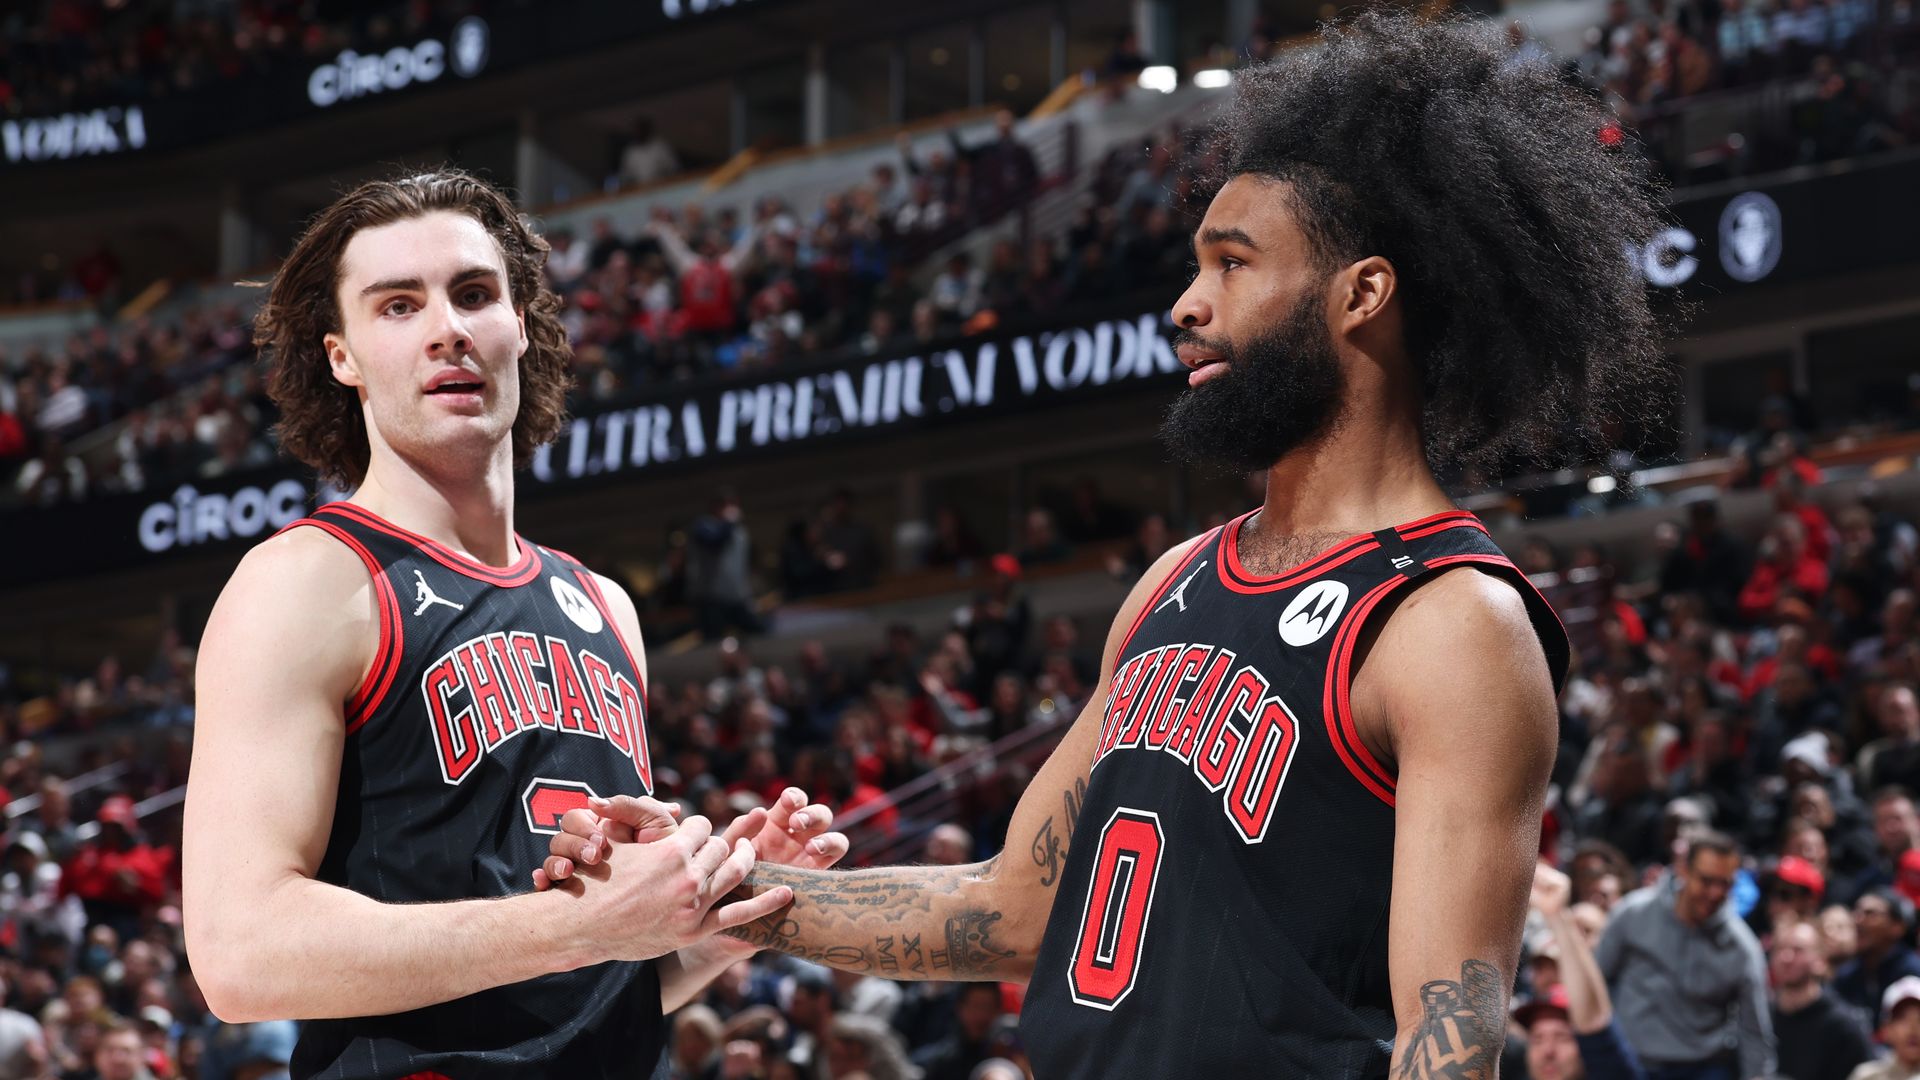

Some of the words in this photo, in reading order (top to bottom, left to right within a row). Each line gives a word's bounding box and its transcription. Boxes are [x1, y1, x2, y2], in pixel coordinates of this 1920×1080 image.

[716, 342, 998, 452] PREMIUM
[1012, 313, 1181, 395] VODK
[1391, 555, 1415, 570] 10
[421, 631, 654, 796] CHICAGO
[1067, 807, 1165, 1011] 0
